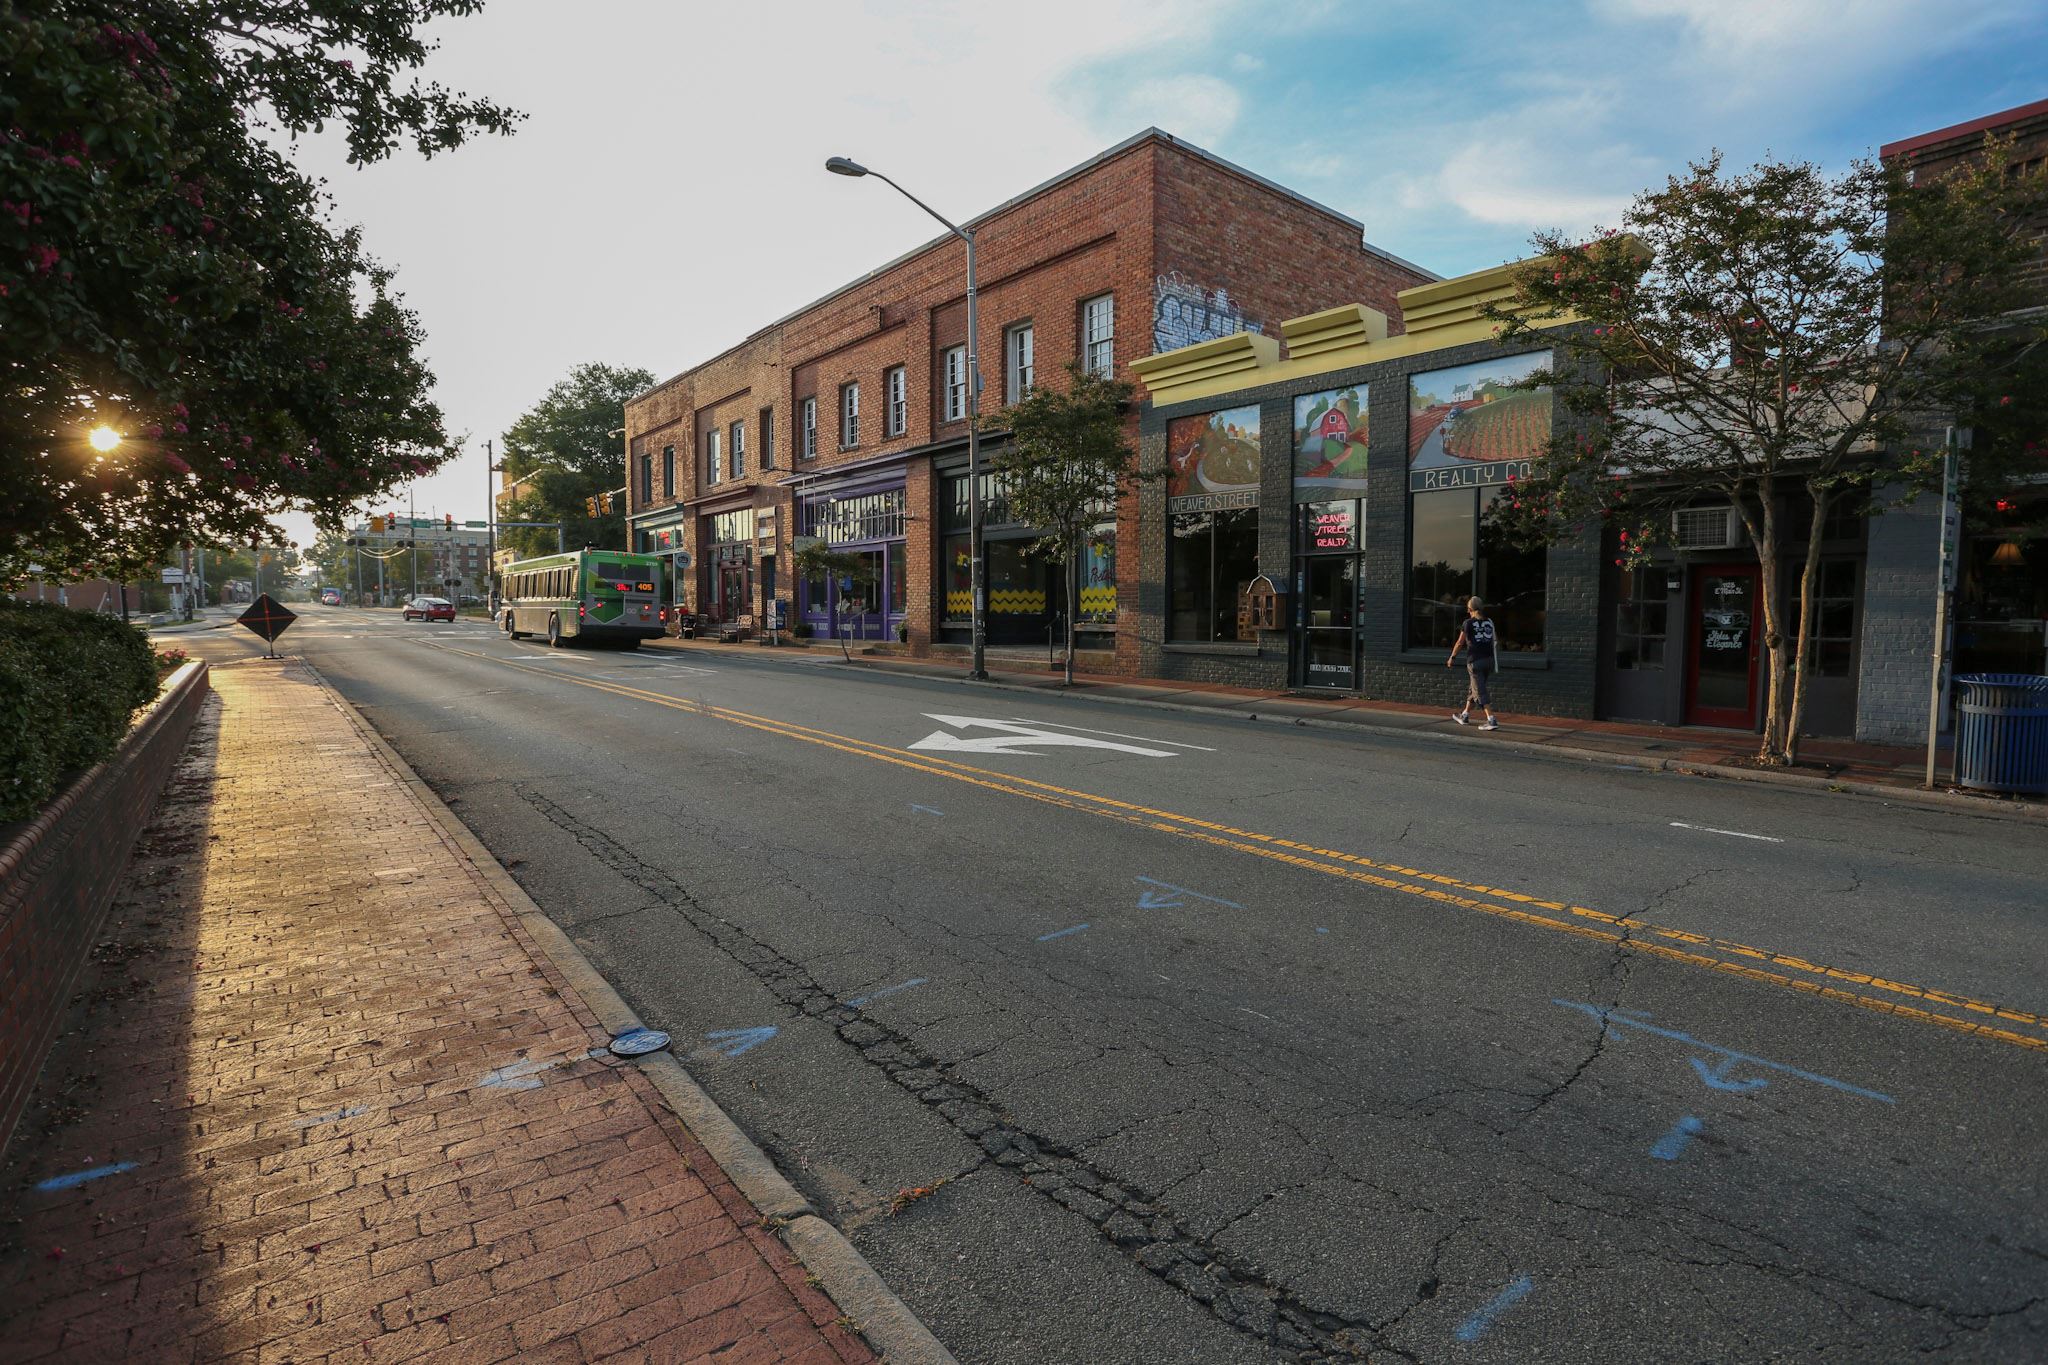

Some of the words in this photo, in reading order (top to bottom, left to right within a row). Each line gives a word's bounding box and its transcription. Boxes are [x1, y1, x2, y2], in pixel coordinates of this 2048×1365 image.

[1424, 465, 1495, 489] REALTY
[1171, 496, 1212, 512] WEAVER
[1215, 491, 1257, 508] STREET
[1316, 513, 1351, 523] WEAVER
[1314, 525, 1347, 536] STREET
[1316, 538, 1347, 547] REALTY
[638, 583, 653, 591] 405
[1708, 630, 1729, 641] Styles
[1733, 630, 1744, 642] of
[1706, 639, 1743, 651] Elegance
[1337, 665, 1353, 673] MAIN
